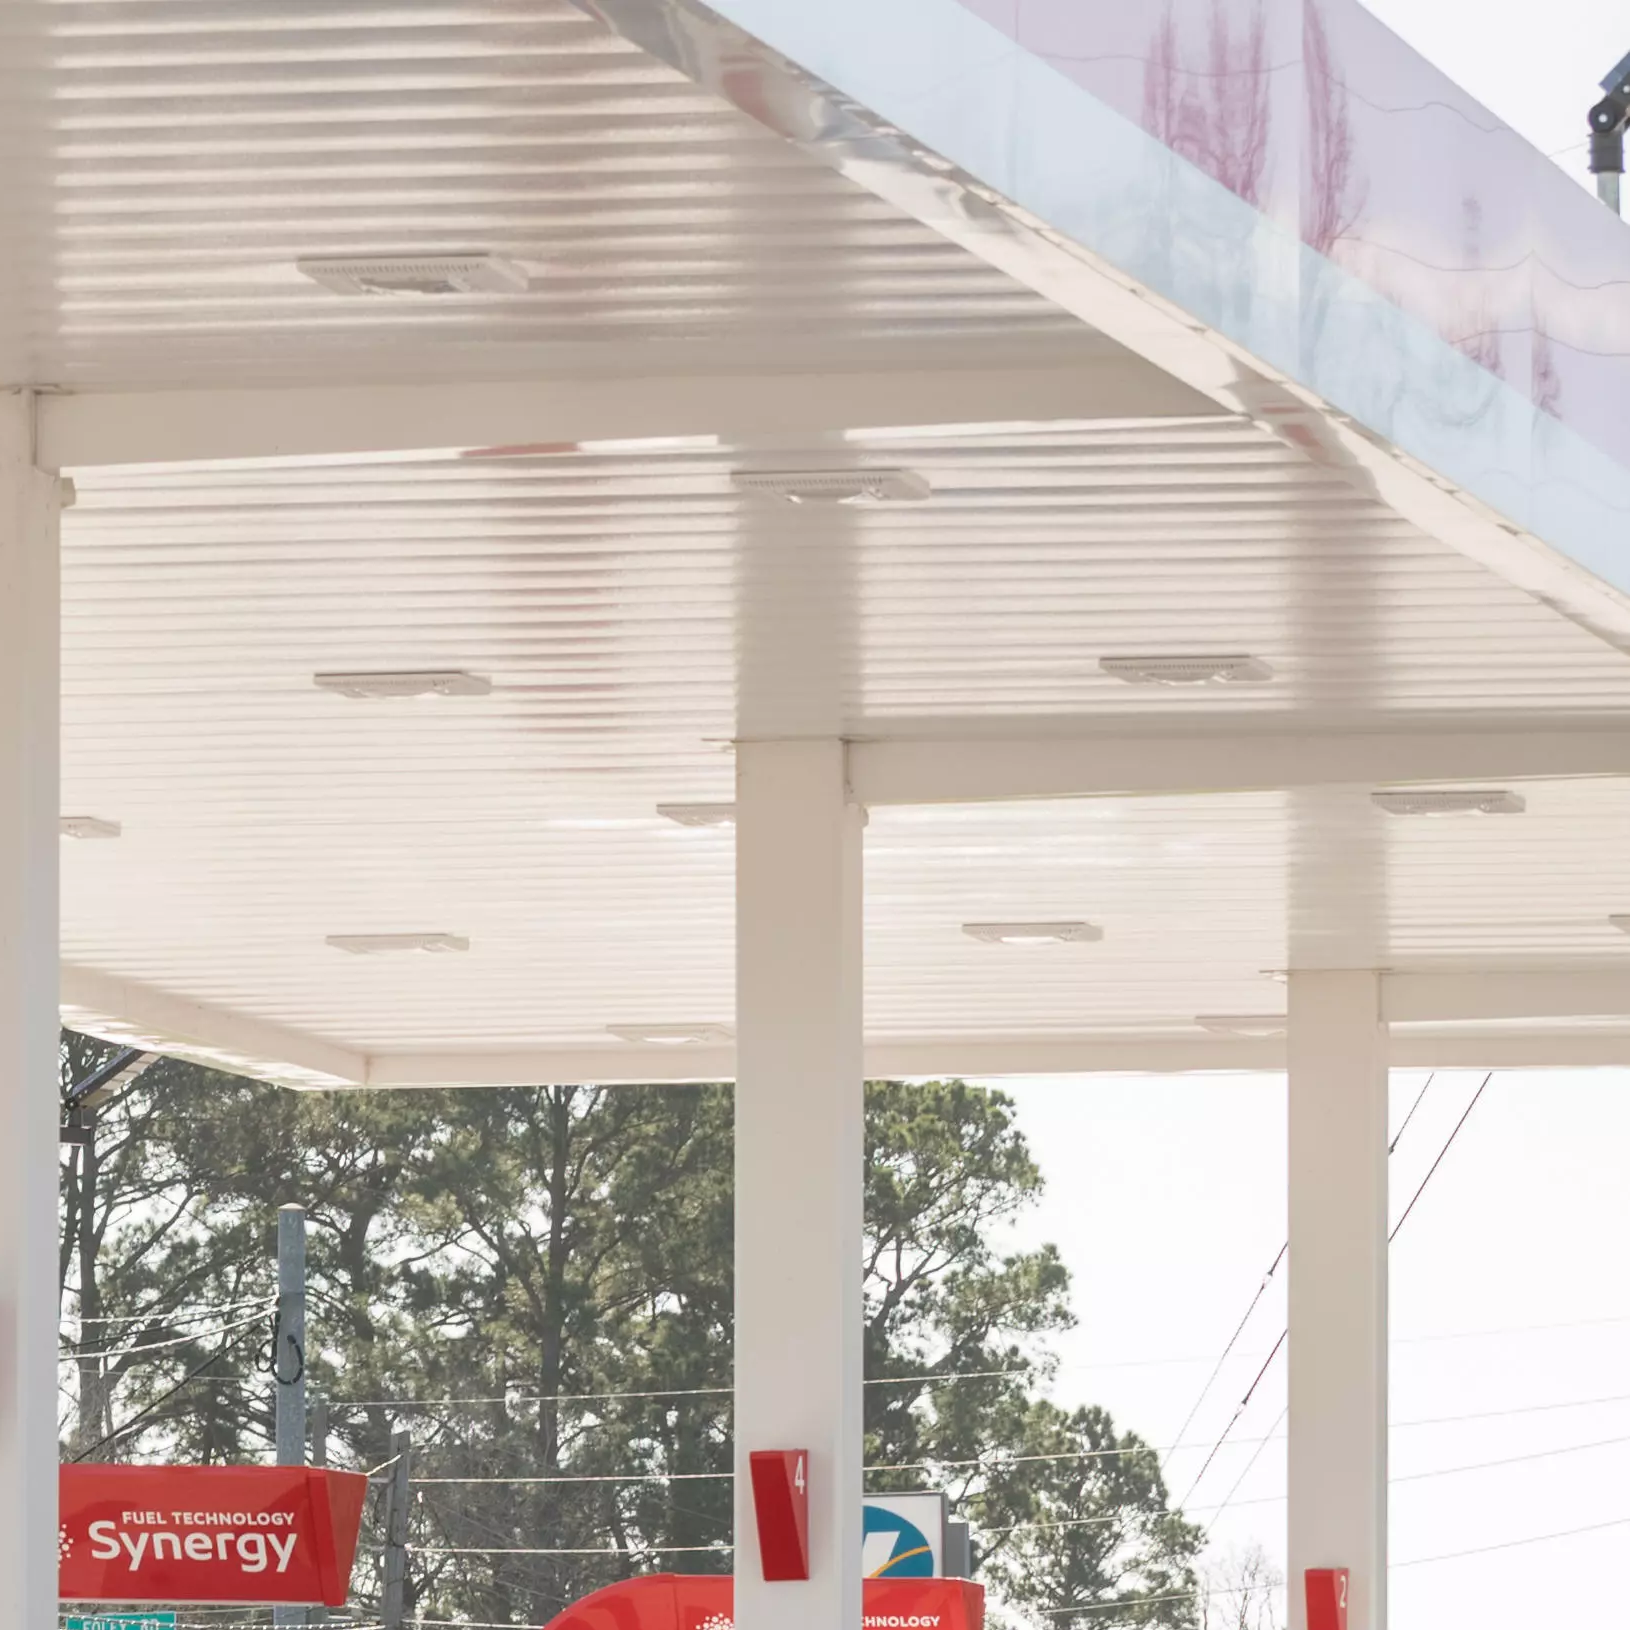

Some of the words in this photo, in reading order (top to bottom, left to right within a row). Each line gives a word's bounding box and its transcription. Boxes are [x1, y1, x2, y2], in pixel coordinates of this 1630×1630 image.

[794, 1455, 805, 1494] 4
[122, 1511, 167, 1525] FUEL
[172, 1512, 294, 1526] TECHNOLOGY
[88, 1520, 297, 1573] Synergy
